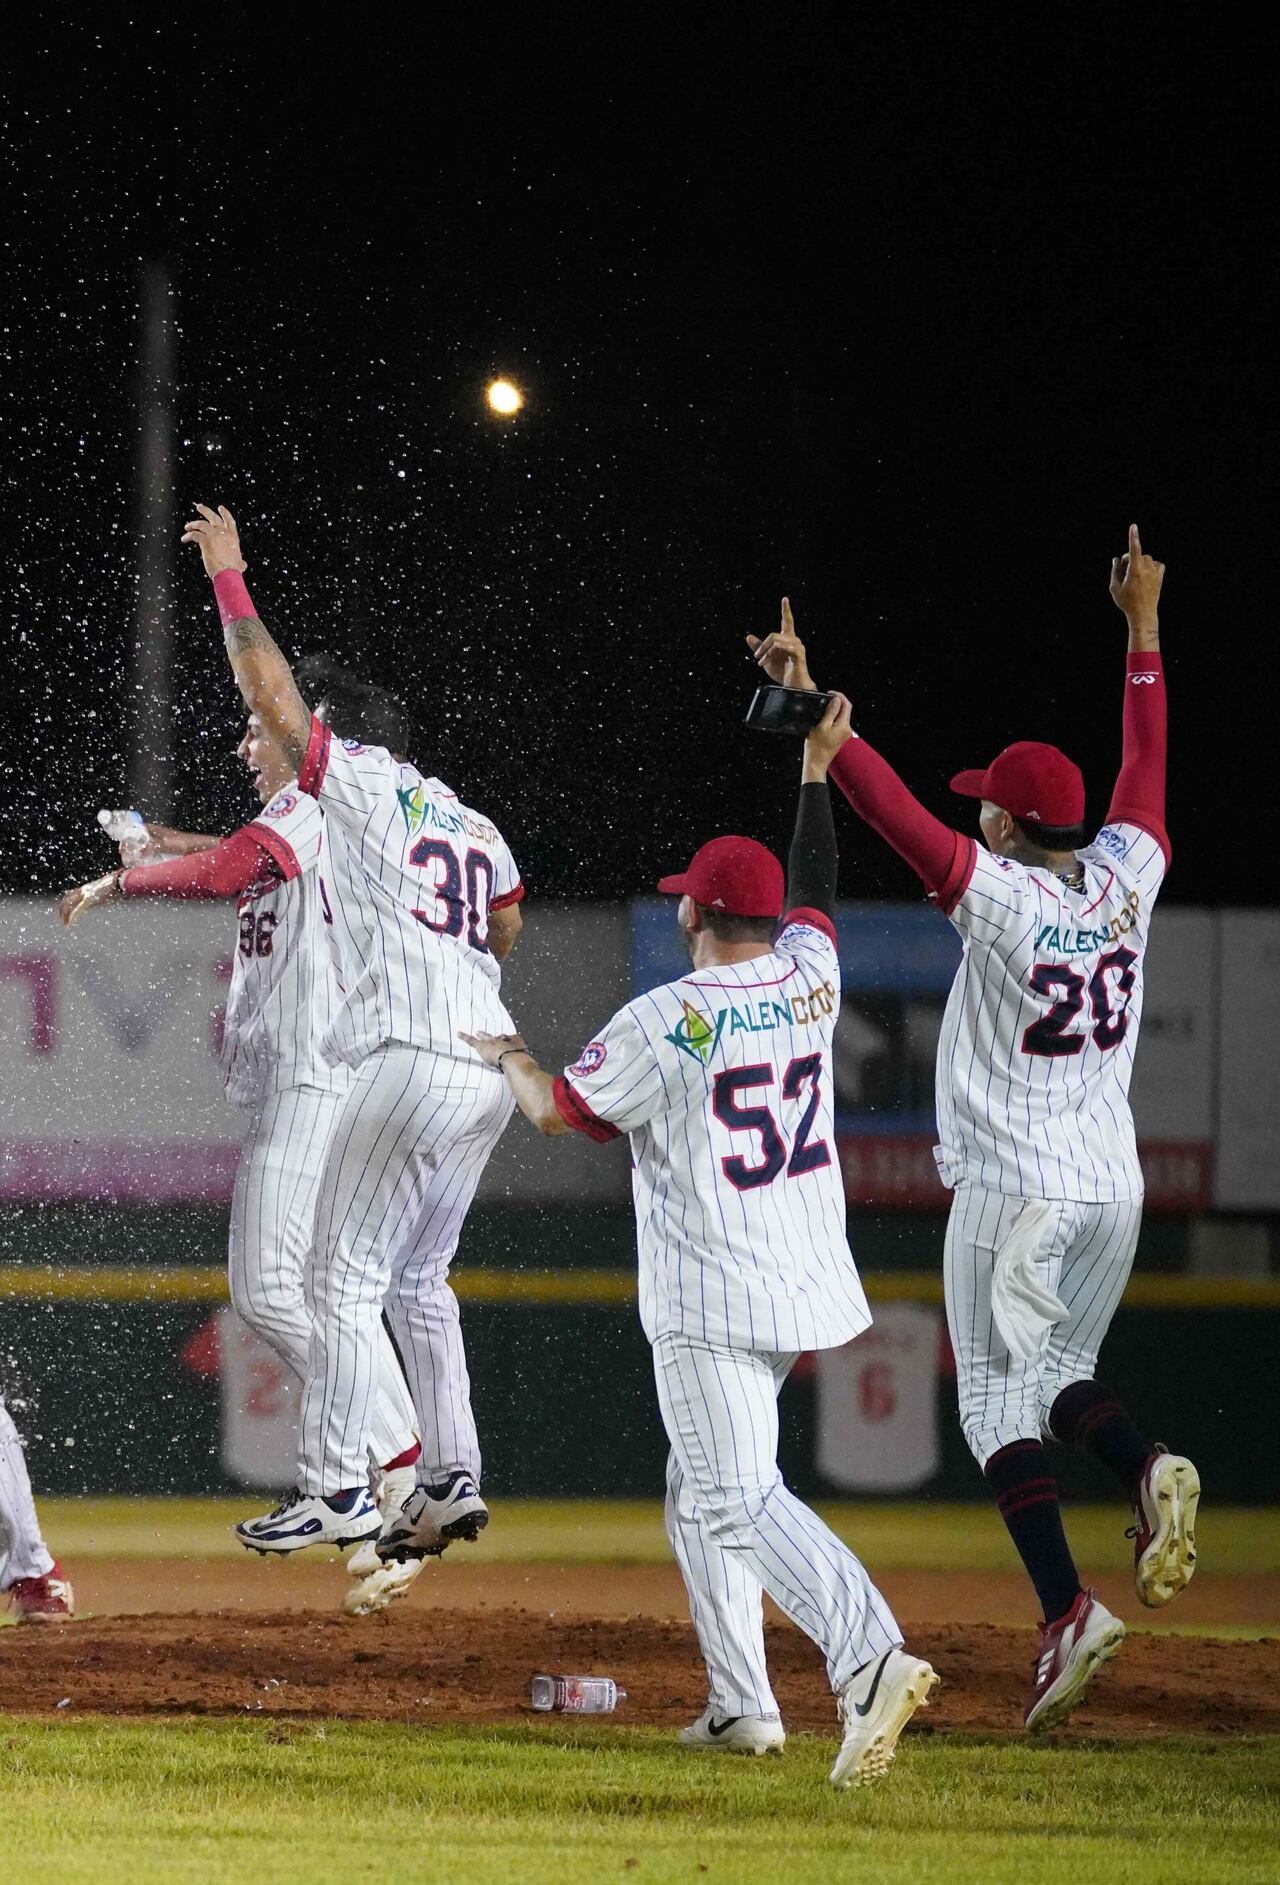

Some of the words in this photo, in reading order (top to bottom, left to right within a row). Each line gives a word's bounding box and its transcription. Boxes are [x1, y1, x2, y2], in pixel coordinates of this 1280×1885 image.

[409, 836, 494, 954] 30
[1021, 944, 1138, 1057] 20
[712, 1051, 832, 1191] 52
[859, 1360, 898, 1424] 6
